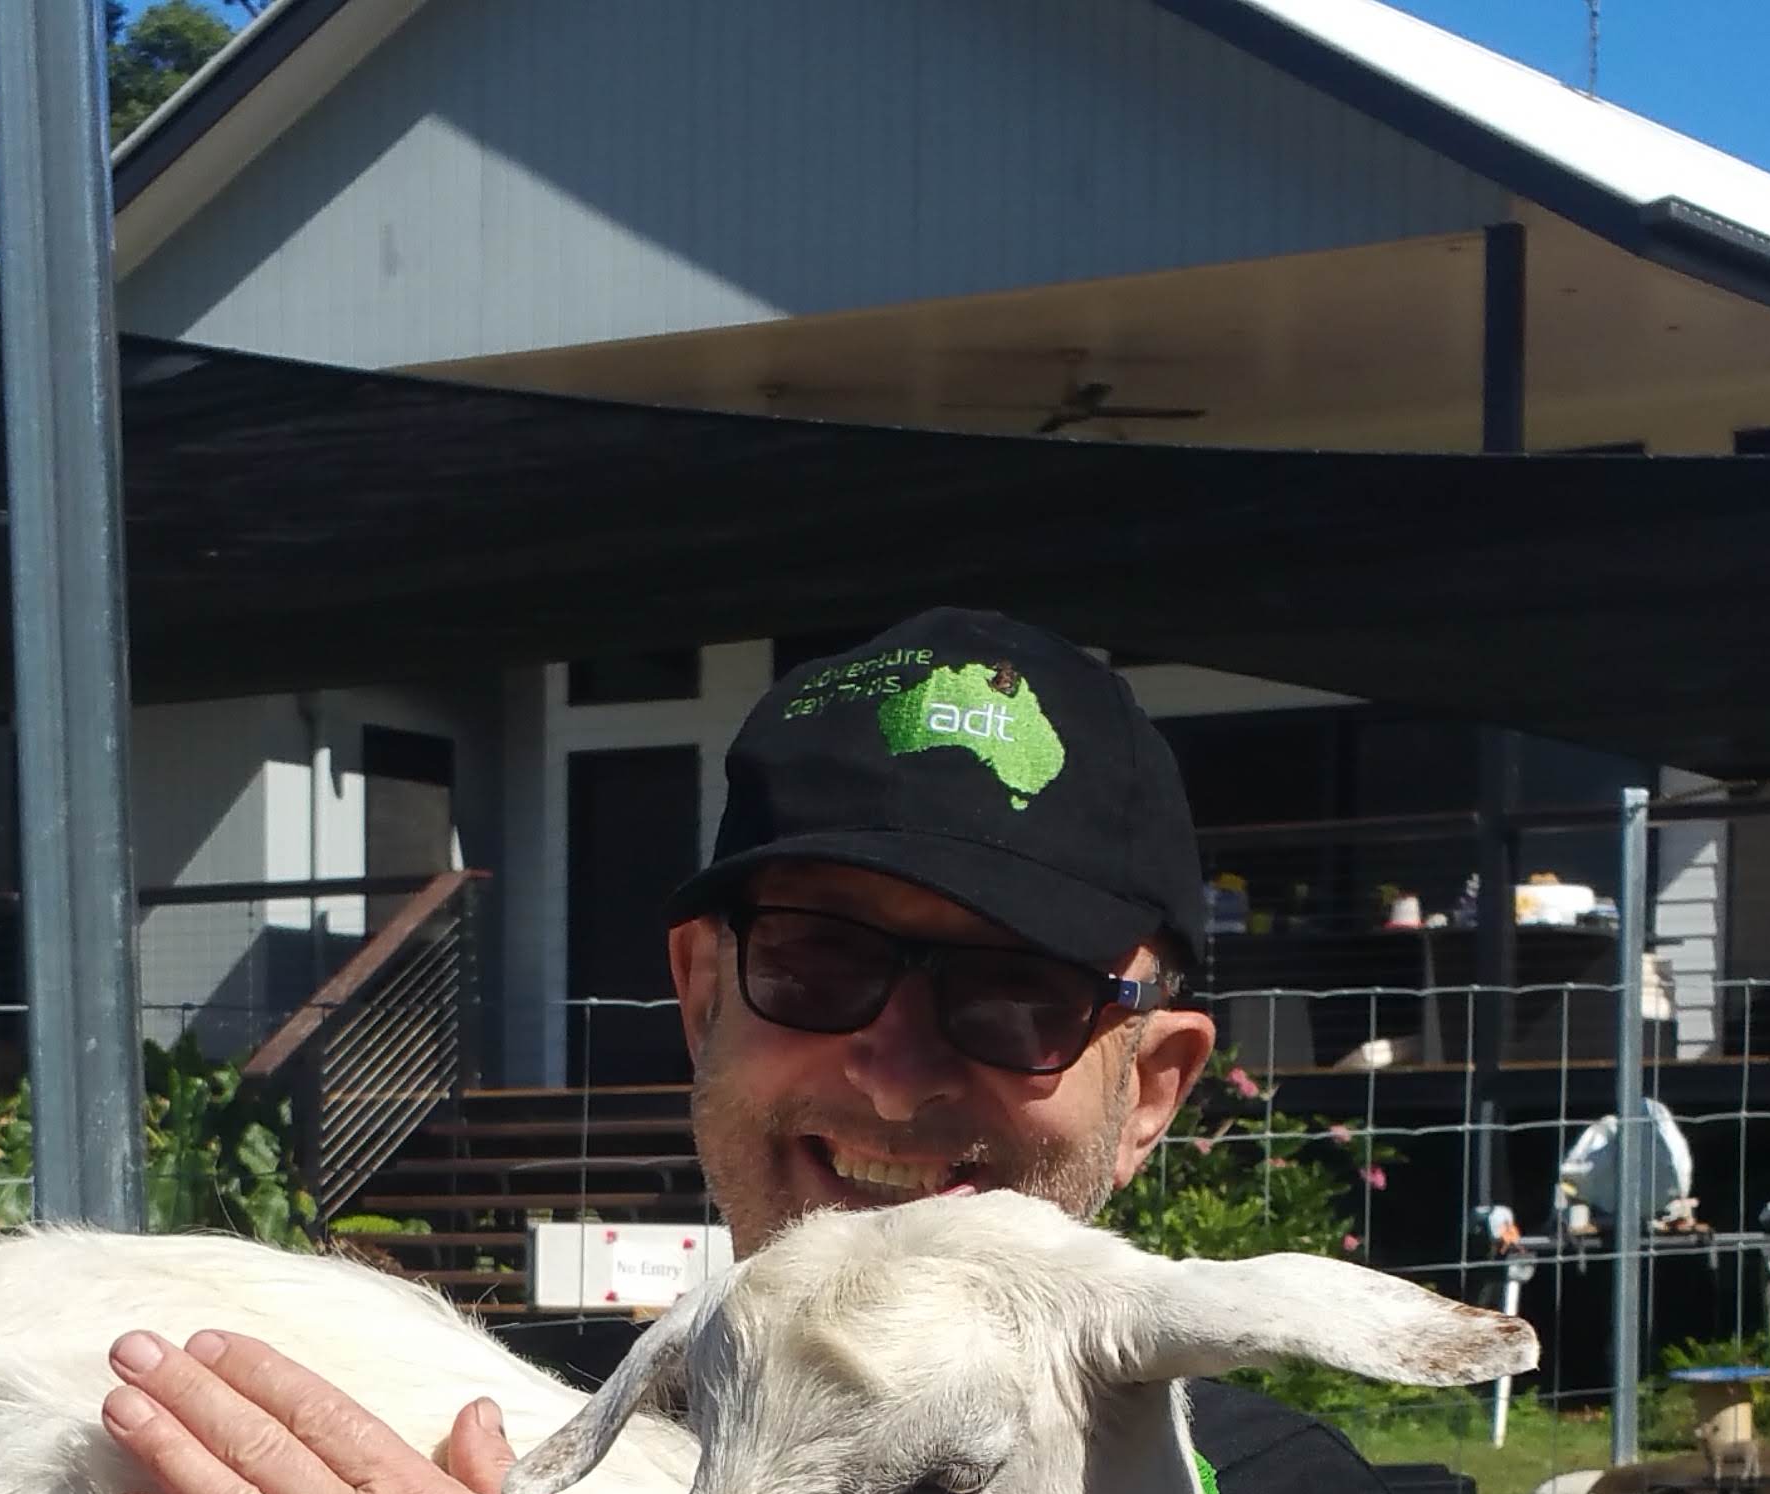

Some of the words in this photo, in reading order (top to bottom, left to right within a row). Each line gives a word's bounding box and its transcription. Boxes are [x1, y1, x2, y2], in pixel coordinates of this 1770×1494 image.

[928, 702, 1015, 743] adt
[616, 1259, 638, 1274] No
[641, 1259, 684, 1281] Entry
